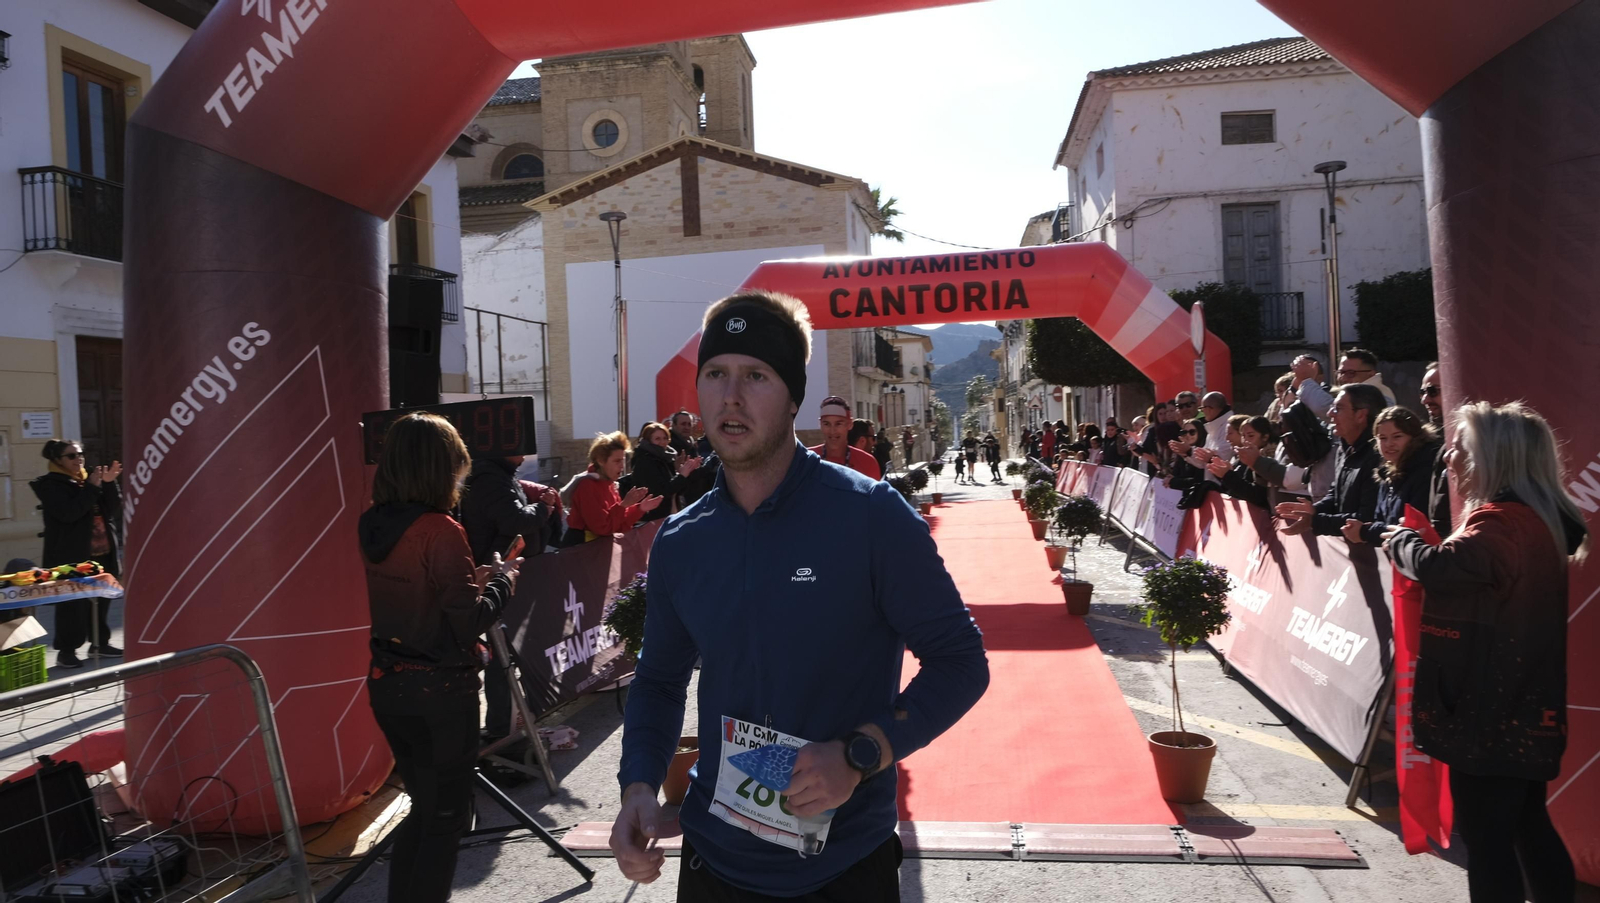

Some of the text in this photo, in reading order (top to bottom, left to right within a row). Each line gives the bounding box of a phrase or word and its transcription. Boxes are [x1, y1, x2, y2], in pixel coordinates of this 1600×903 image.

[822, 251, 1035, 279] AYUNTAMIENTO
[829, 279, 1030, 318] CANTORIA
[1286, 606, 1369, 666] TEAMERGY
[734, 735, 746, 748] LA
[738, 721, 779, 744] IV CxM
